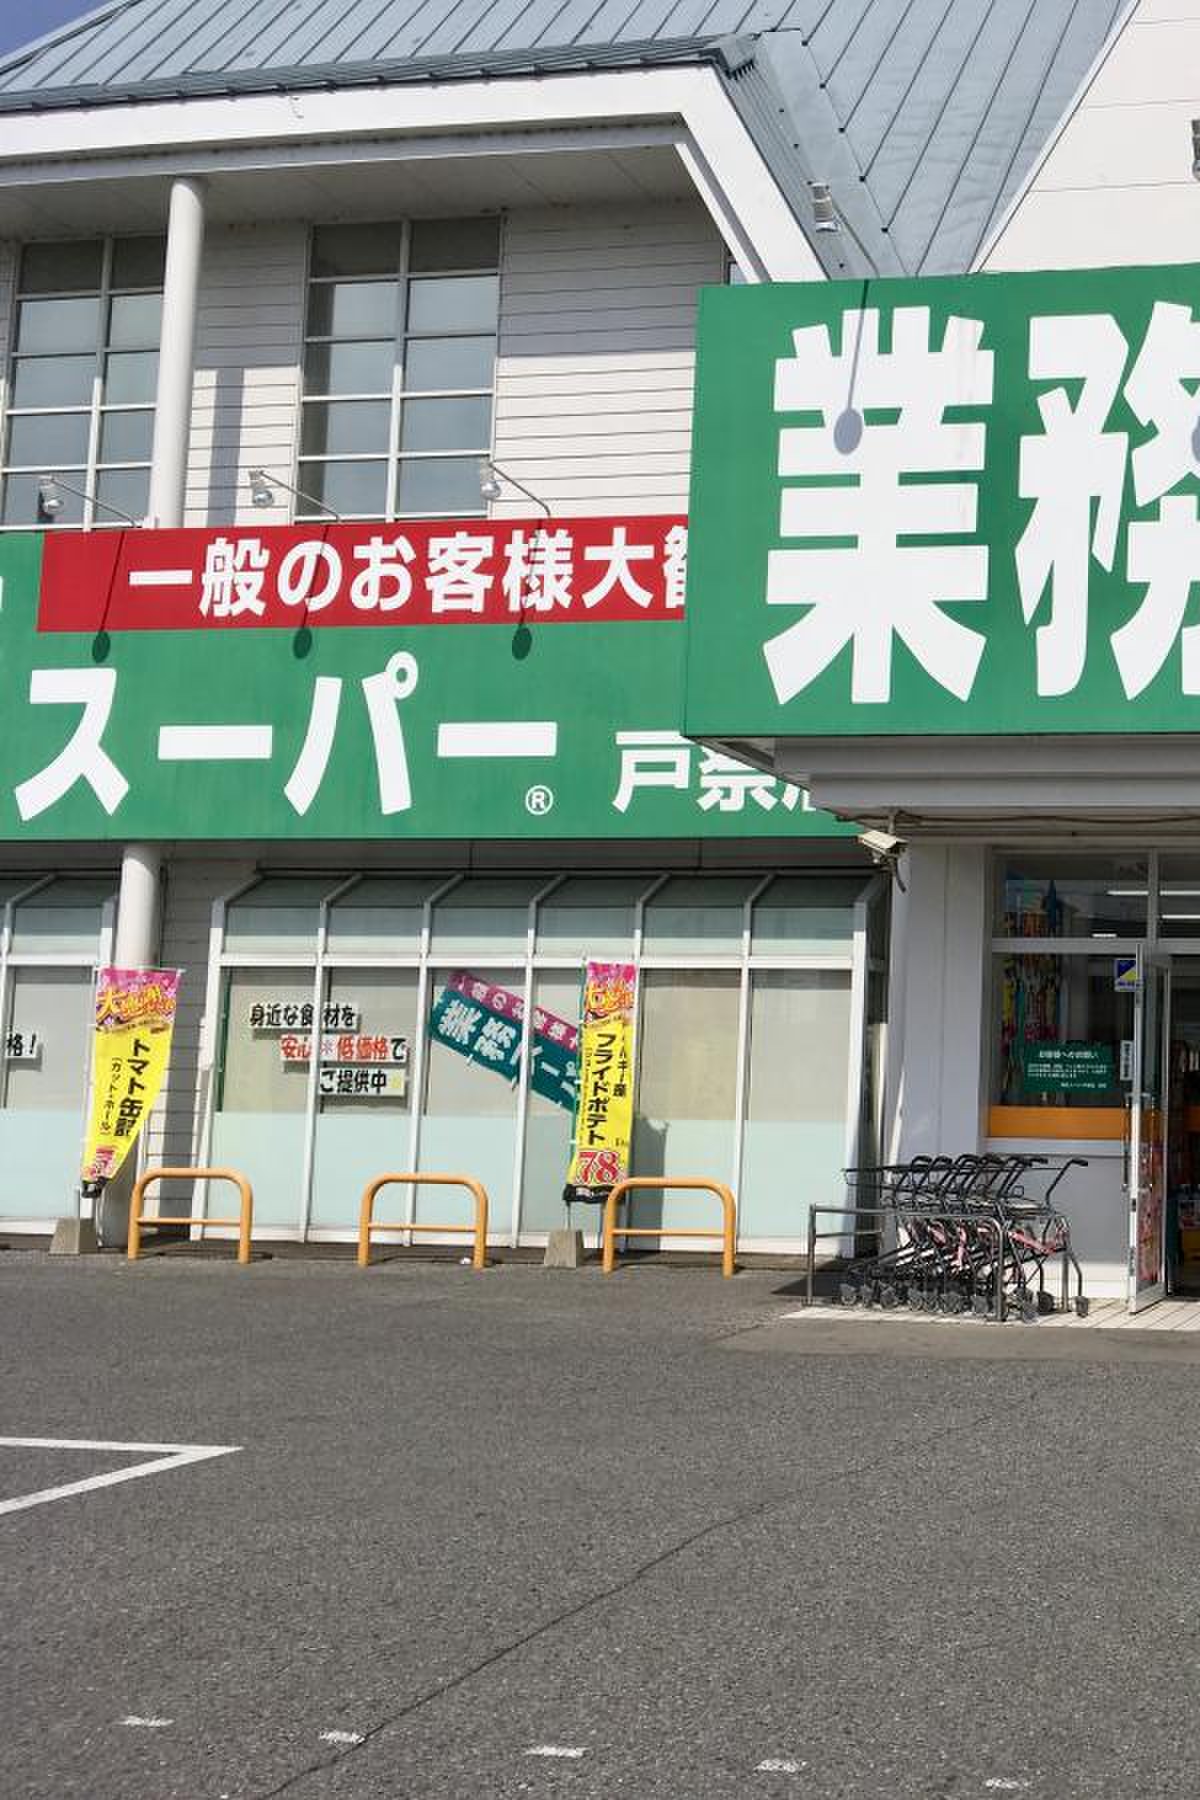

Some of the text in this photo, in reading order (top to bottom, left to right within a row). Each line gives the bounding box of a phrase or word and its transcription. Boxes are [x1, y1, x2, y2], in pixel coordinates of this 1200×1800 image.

[612, 731, 818, 814] 戸祭
[113, 1038, 152, 1138] トマト缶詰
[586, 1032, 617, 1146] フライドポテト
